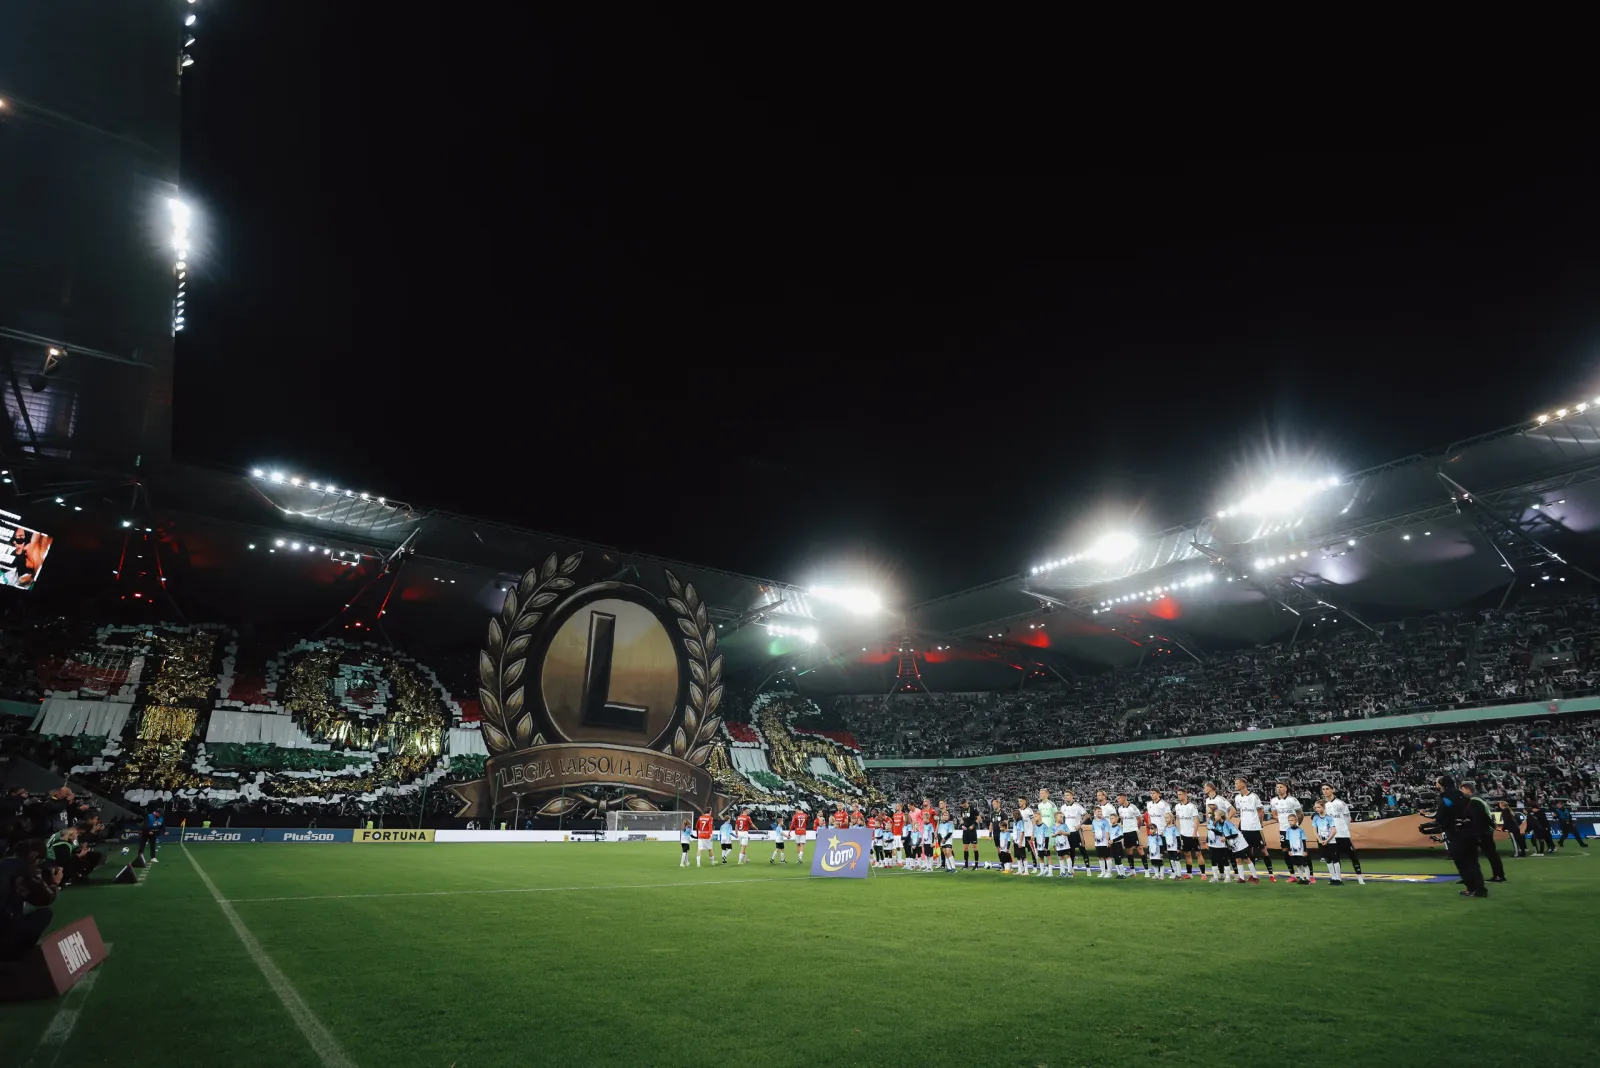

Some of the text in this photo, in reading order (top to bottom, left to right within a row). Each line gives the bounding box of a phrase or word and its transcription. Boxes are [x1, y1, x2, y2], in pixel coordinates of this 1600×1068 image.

[580, 609, 649, 735] L
[500, 755, 698, 795] LEGIA VARSOVIA AETERNA
[701, 820, 707, 831] 7
[797, 818, 806, 828] 17
[183, 829, 241, 841] Plus500
[282, 830, 335, 841] Plus500
[362, 831, 427, 841] FORTUNA
[829, 847, 854, 866] LOTTO
